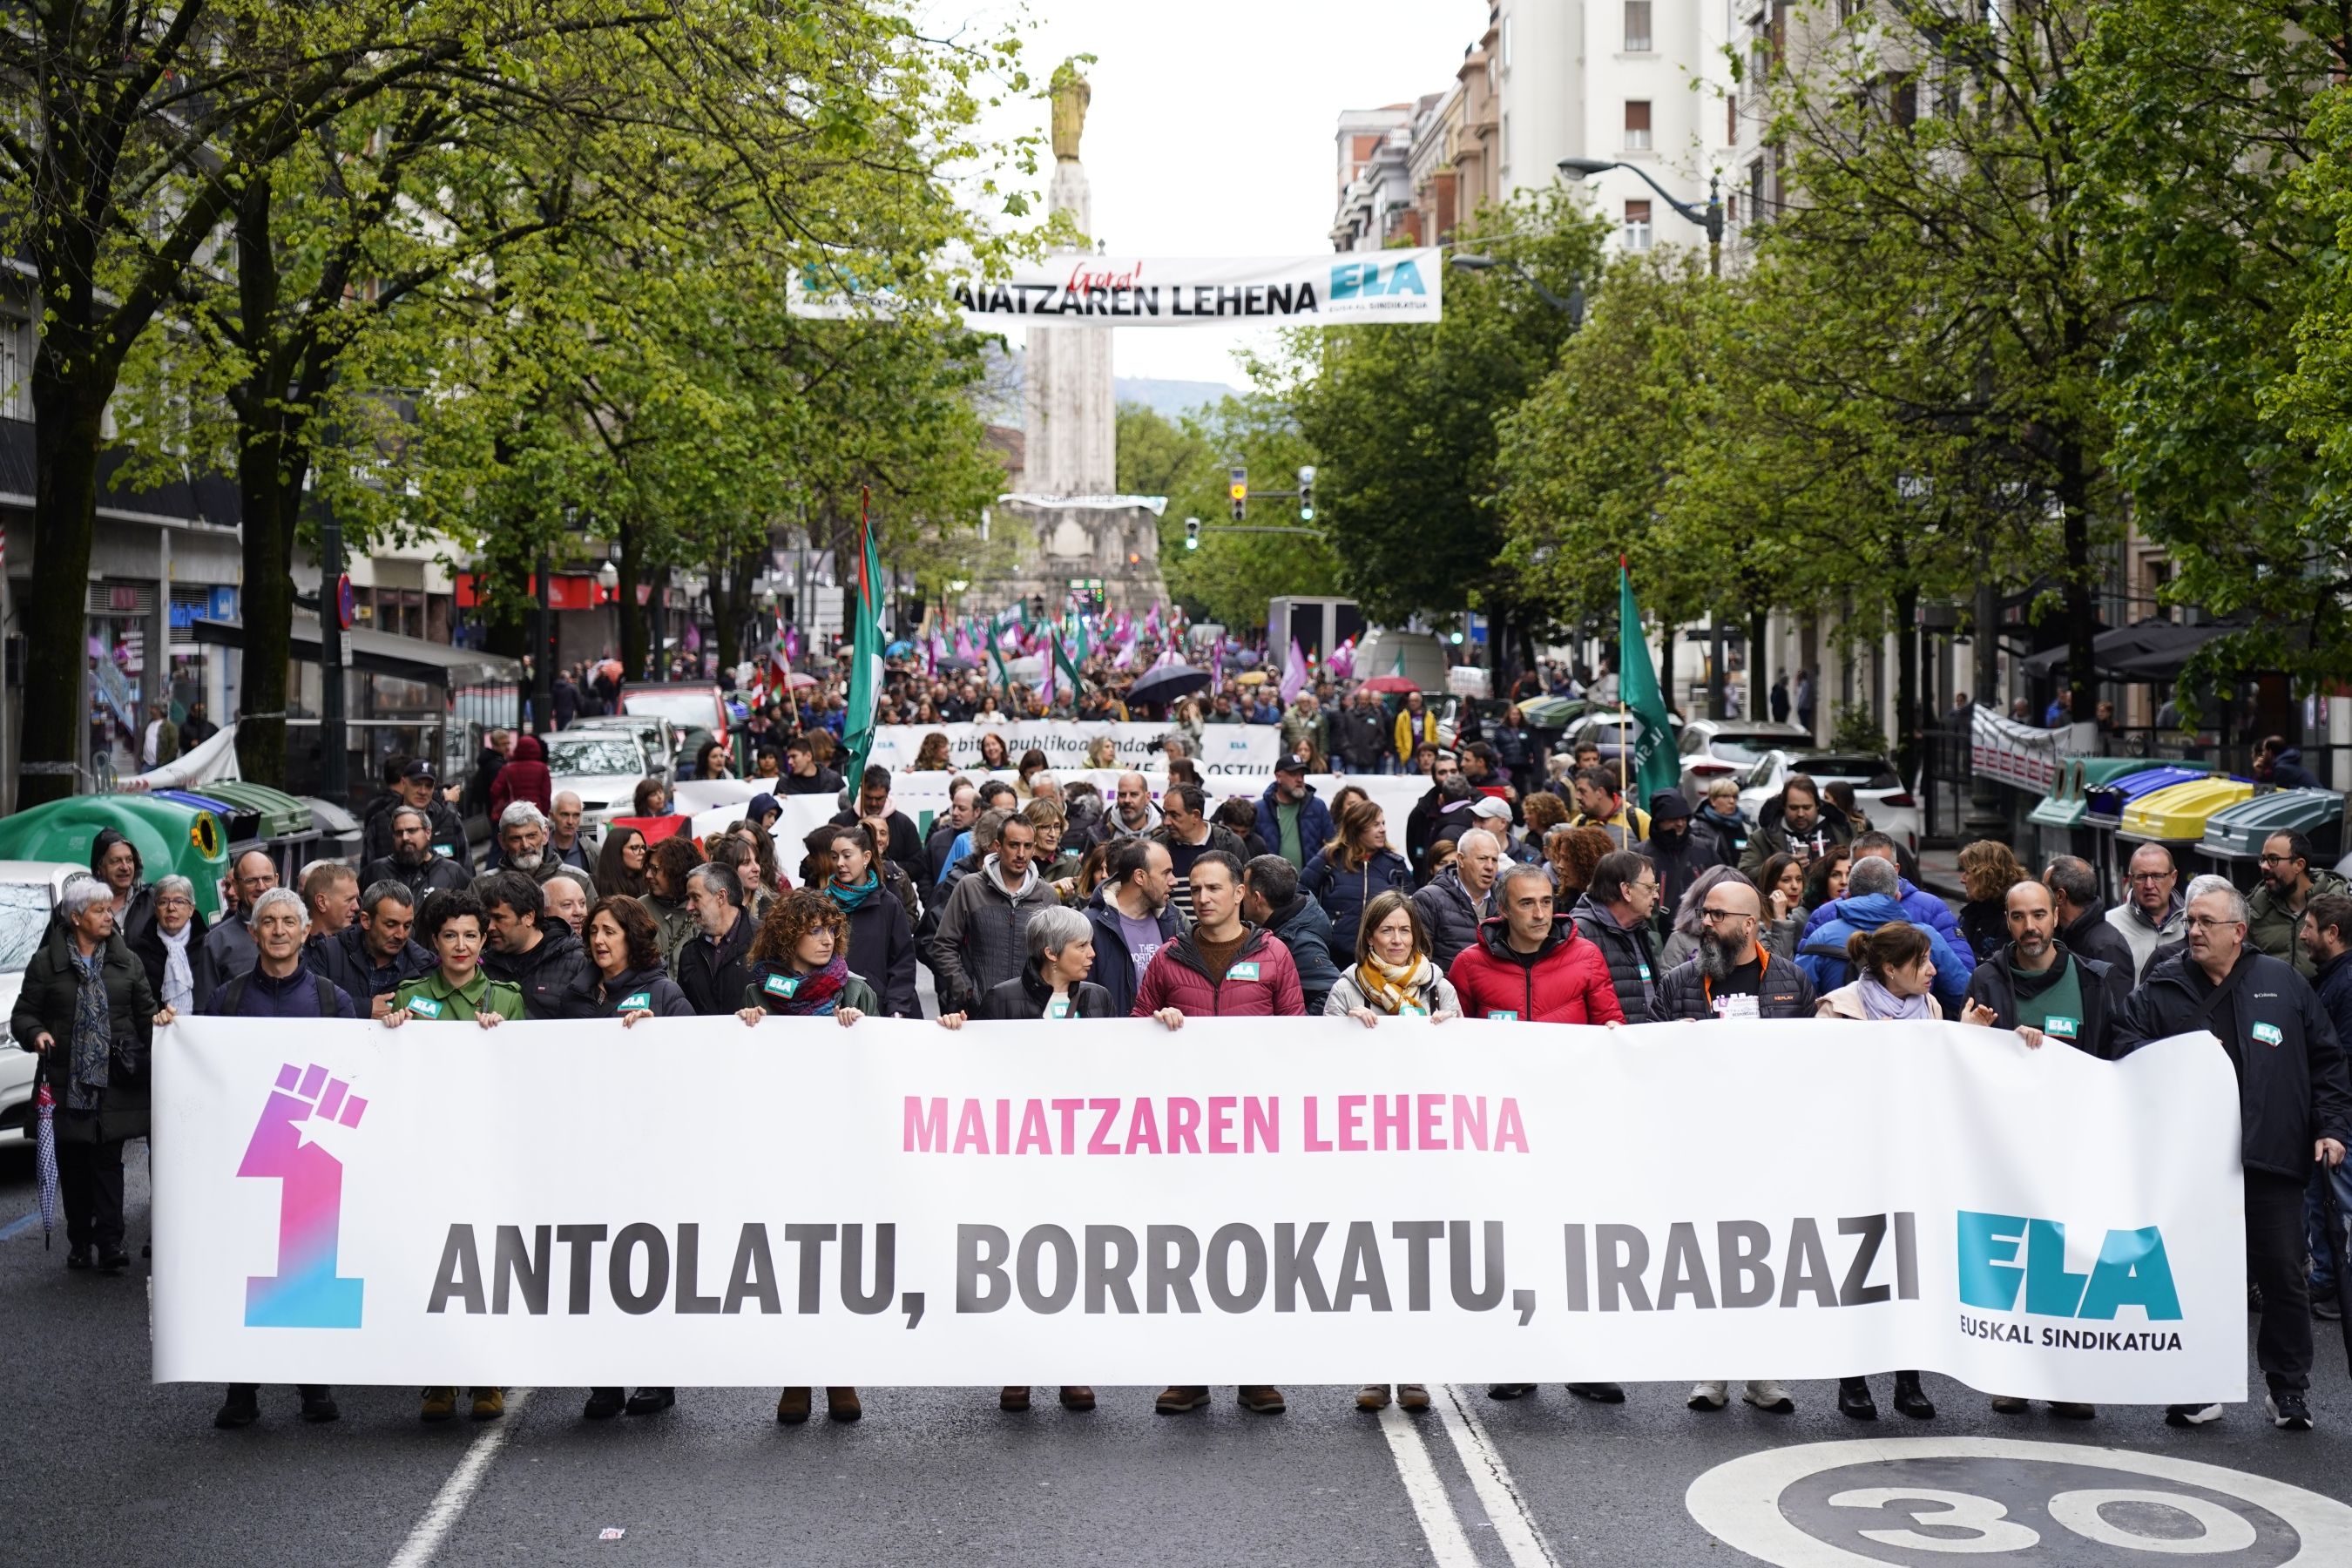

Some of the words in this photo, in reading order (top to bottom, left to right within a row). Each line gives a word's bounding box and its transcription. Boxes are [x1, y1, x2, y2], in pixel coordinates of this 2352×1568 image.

[1067, 261, 1143, 297] Gora!
[1330, 260, 1426, 300] ELA
[953, 283, 1159, 316] AIATZAREN
[1173, 282, 1319, 316] LEHENA
[1139, 943, 1155, 953] THE
[768, 977, 792, 992] ELA
[413, 999, 436, 1015] ELA
[2049, 1019, 2073, 1032] ELA
[903, 1096, 1280, 1155] MAIATZAREN
[1303, 1094, 1530, 1153] LEHENA
[426, 1222, 925, 1329] ANTOLATU,
[956, 1220, 1536, 1327] BORROKATU,
[1564, 1212, 1920, 1312] IRABAZI
[1957, 1210, 2184, 1321] ELA
[1960, 1315, 2034, 1345] EUSKAL
[2041, 1327, 2183, 1352] SINDIKATUA
[1828, 1486, 2258, 1553] 30
